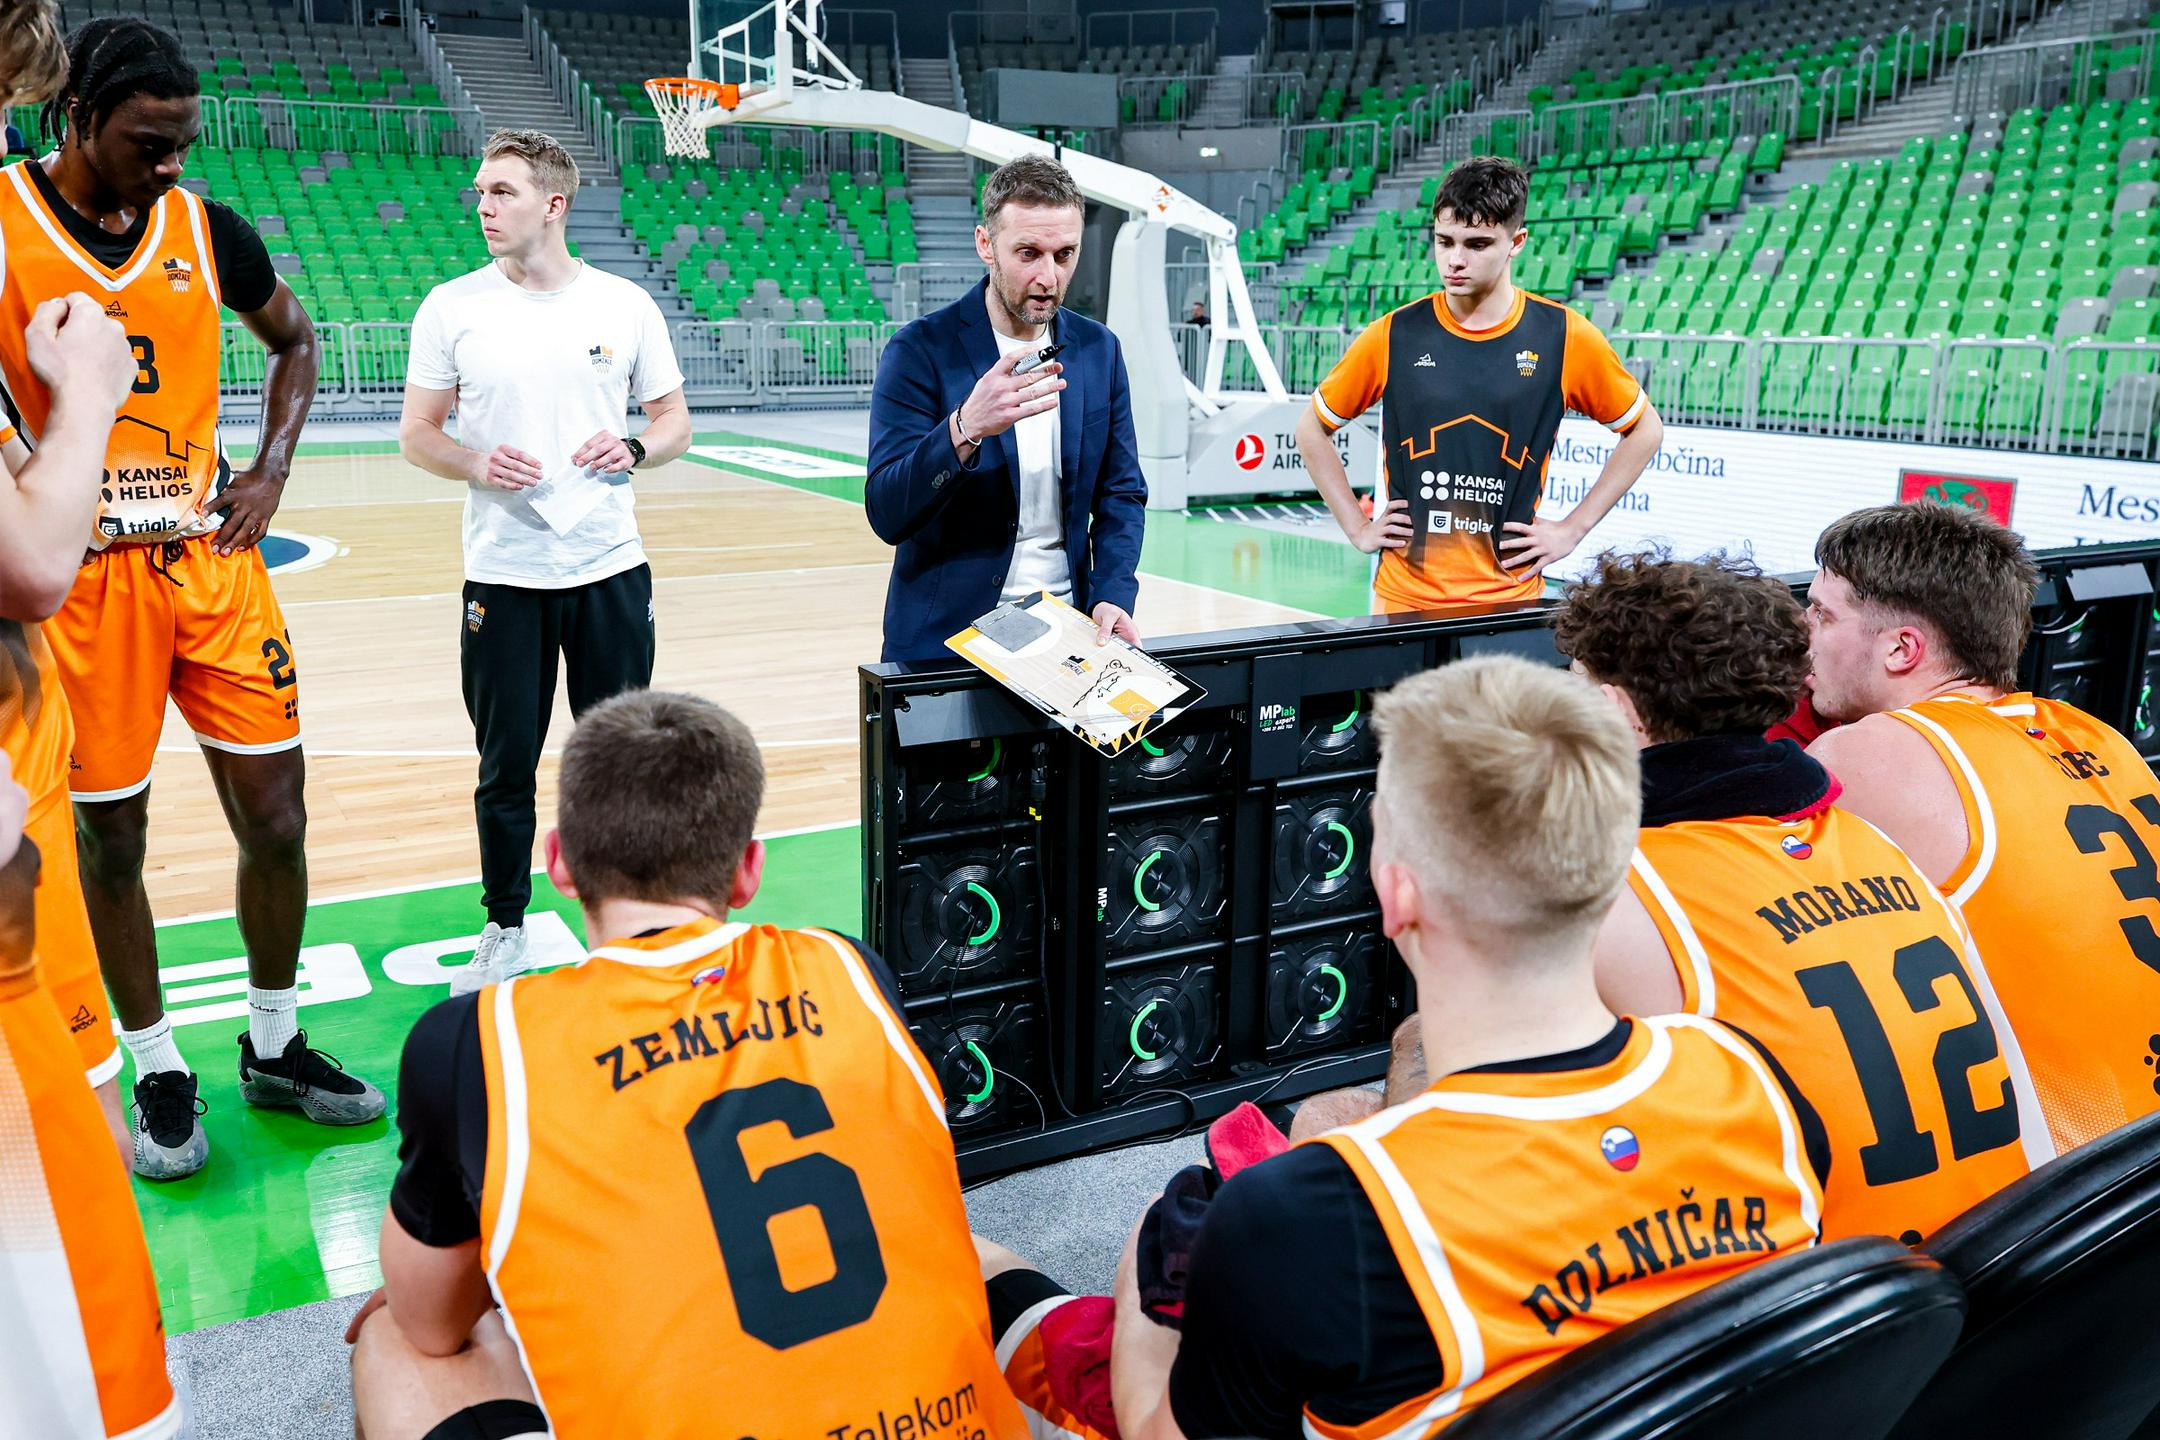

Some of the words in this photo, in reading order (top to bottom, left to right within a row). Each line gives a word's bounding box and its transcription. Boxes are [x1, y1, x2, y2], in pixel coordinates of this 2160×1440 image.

[117, 465, 188, 483] KANSAI
[119, 482, 193, 501] HELIOS
[1453, 488, 1505, 506] HELIOS
[128, 516, 180, 534] trigla
[1260, 704, 1295, 720] MPlab
[1097, 887, 1108, 922] MPlab
[1755, 875, 1921, 945] MORANO
[594, 990, 824, 1093] ZEMLJIĆ
[1794, 935, 2021, 1187] 12
[684, 1076, 888, 1351] 6
[1520, 1186, 1778, 1336] DOLNIČAR
